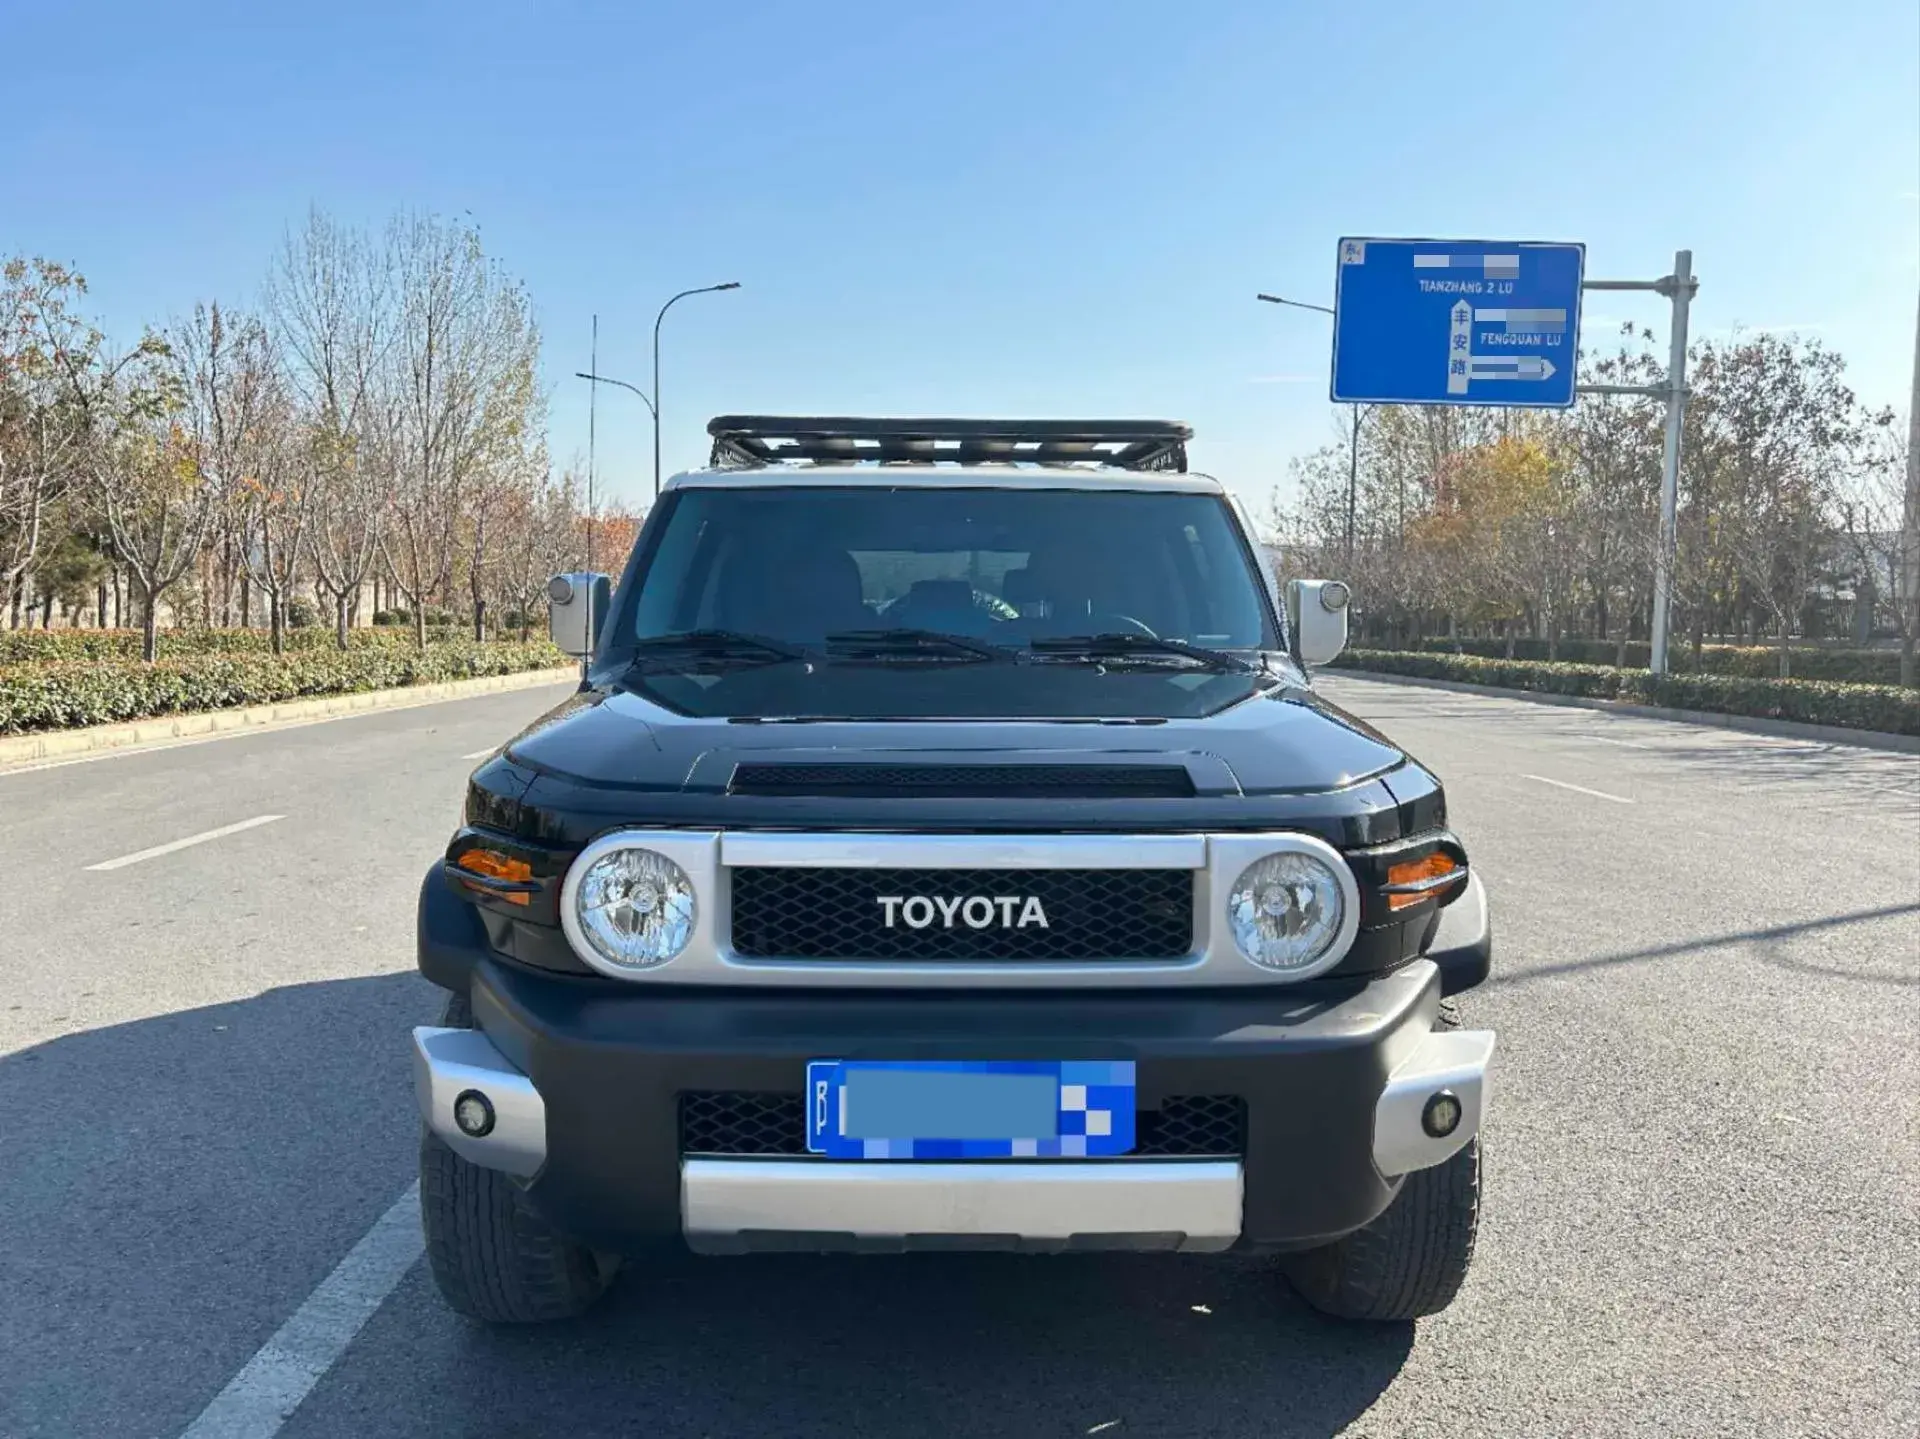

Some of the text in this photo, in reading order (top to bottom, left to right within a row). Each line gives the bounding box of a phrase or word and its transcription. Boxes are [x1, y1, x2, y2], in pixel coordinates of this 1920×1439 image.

[1419, 279, 1513, 294] TIANZHANG 2 LU
[1451, 308, 1469, 376] 丰安路
[1546, 333, 1561, 347] LU
[876, 895, 1050, 930] TOYOTA
